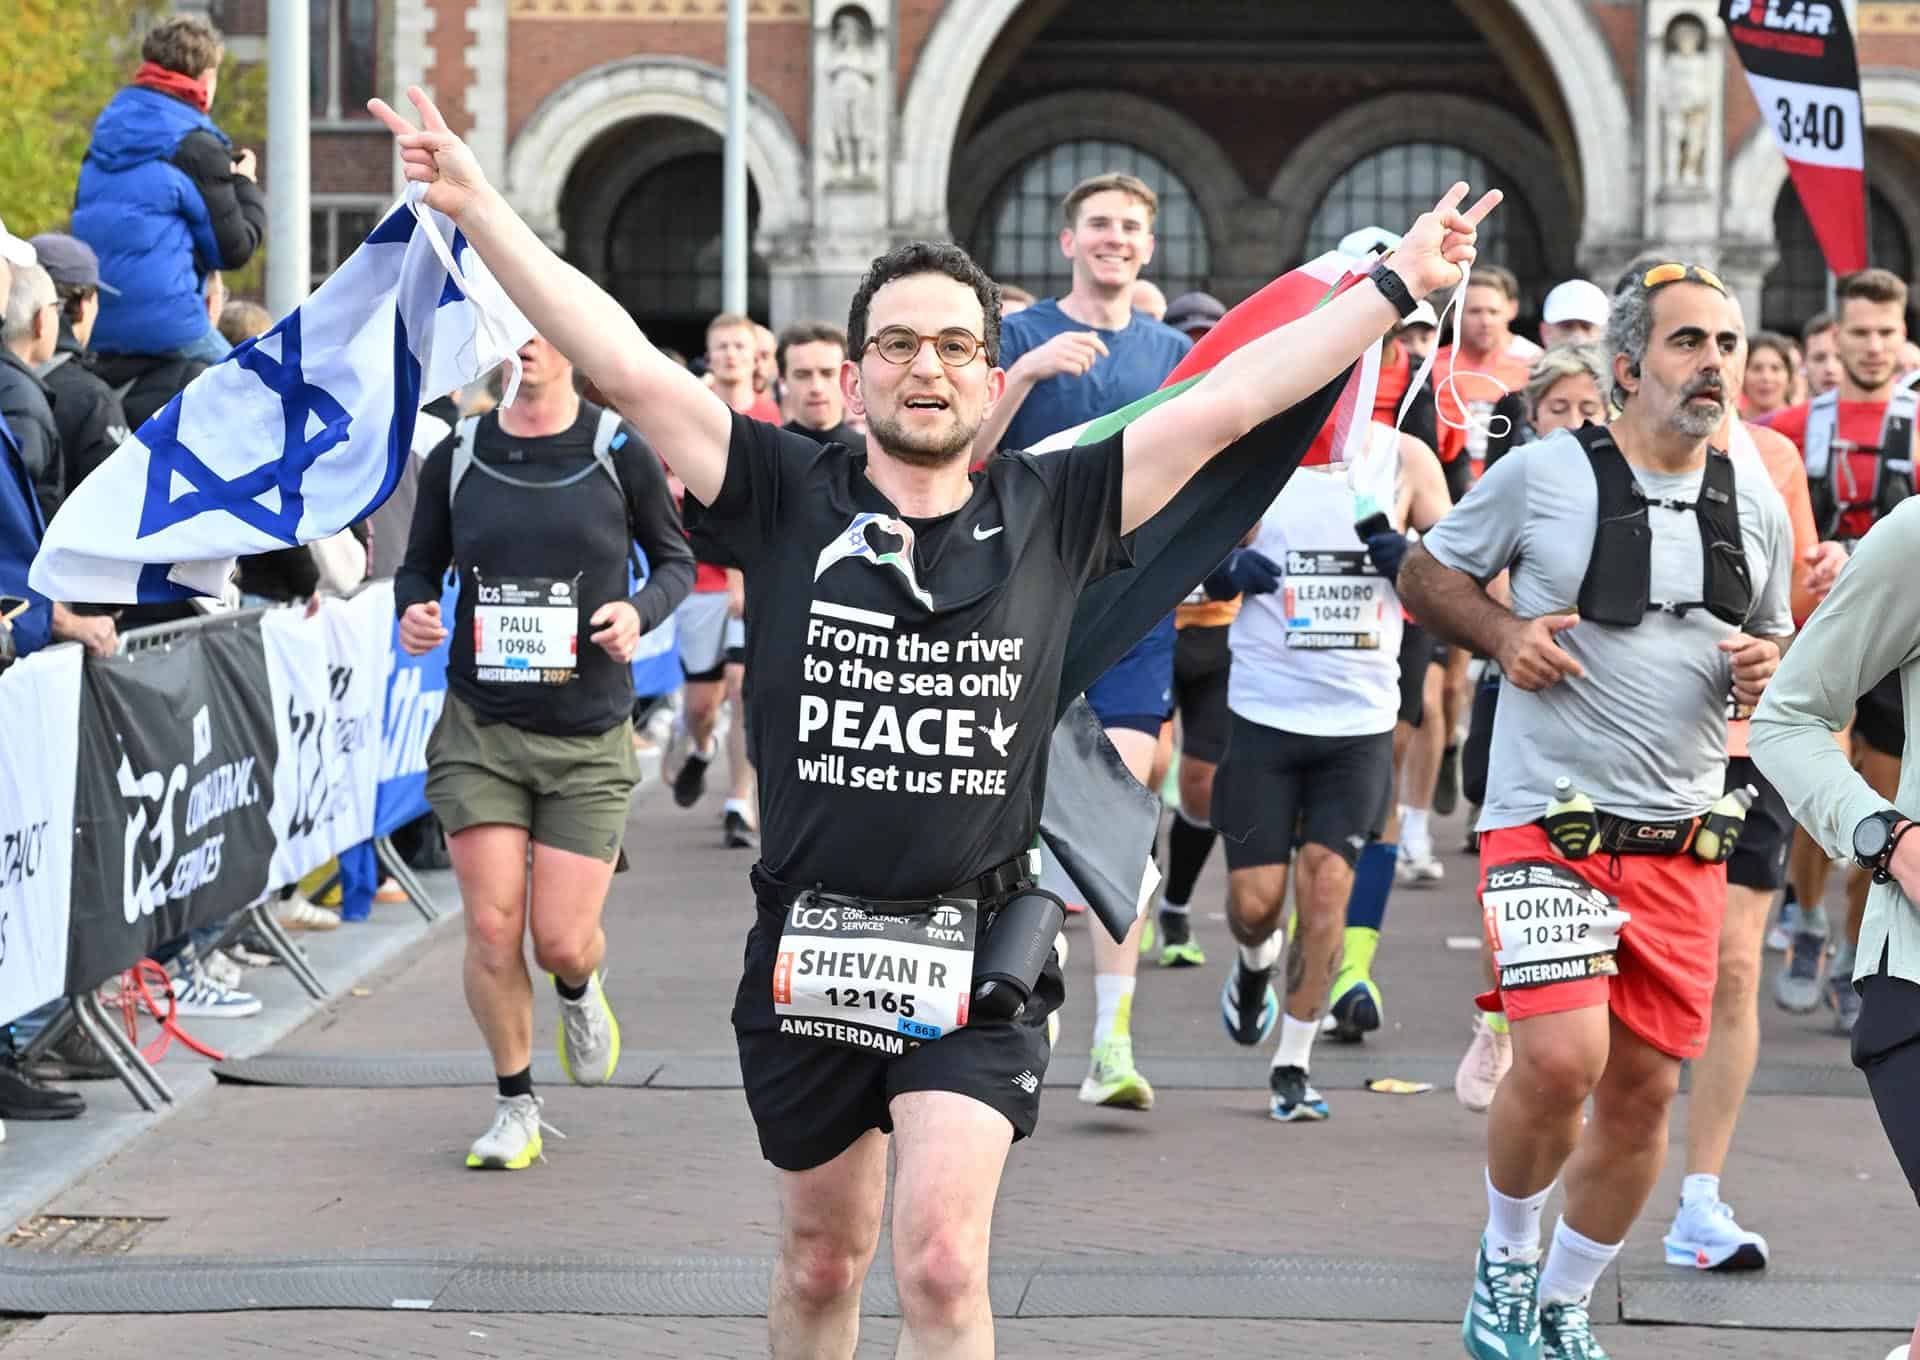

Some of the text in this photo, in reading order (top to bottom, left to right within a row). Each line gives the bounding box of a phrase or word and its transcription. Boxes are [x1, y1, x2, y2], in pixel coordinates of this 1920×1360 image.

[1776, 97, 1843, 151] 3:40
[478, 583, 501, 604] tcs
[1299, 584, 1373, 601] LEANDRO
[500, 615, 543, 633] PAUL
[1313, 606, 1361, 621] 10447
[497, 638, 546, 654] 10986
[807, 618, 1024, 664] From the river
[803, 654, 1023, 701] to the sea only
[798, 695, 976, 758] PEACE
[797, 755, 1008, 797] will set us FREE
[1490, 869, 1526, 889] tcs
[791, 900, 837, 931] tcs
[841, 920, 885, 933] SERVICES
[925, 926, 965, 943] TATA
[797, 948, 919, 985] SHEVAN
[927, 961, 948, 989] R
[1502, 959, 1586, 987] AMSTERDAM
[824, 987, 916, 1018] 12165
[780, 1018, 904, 1056] AMSTERDAM
[902, 1021, 937, 1038] K 863
